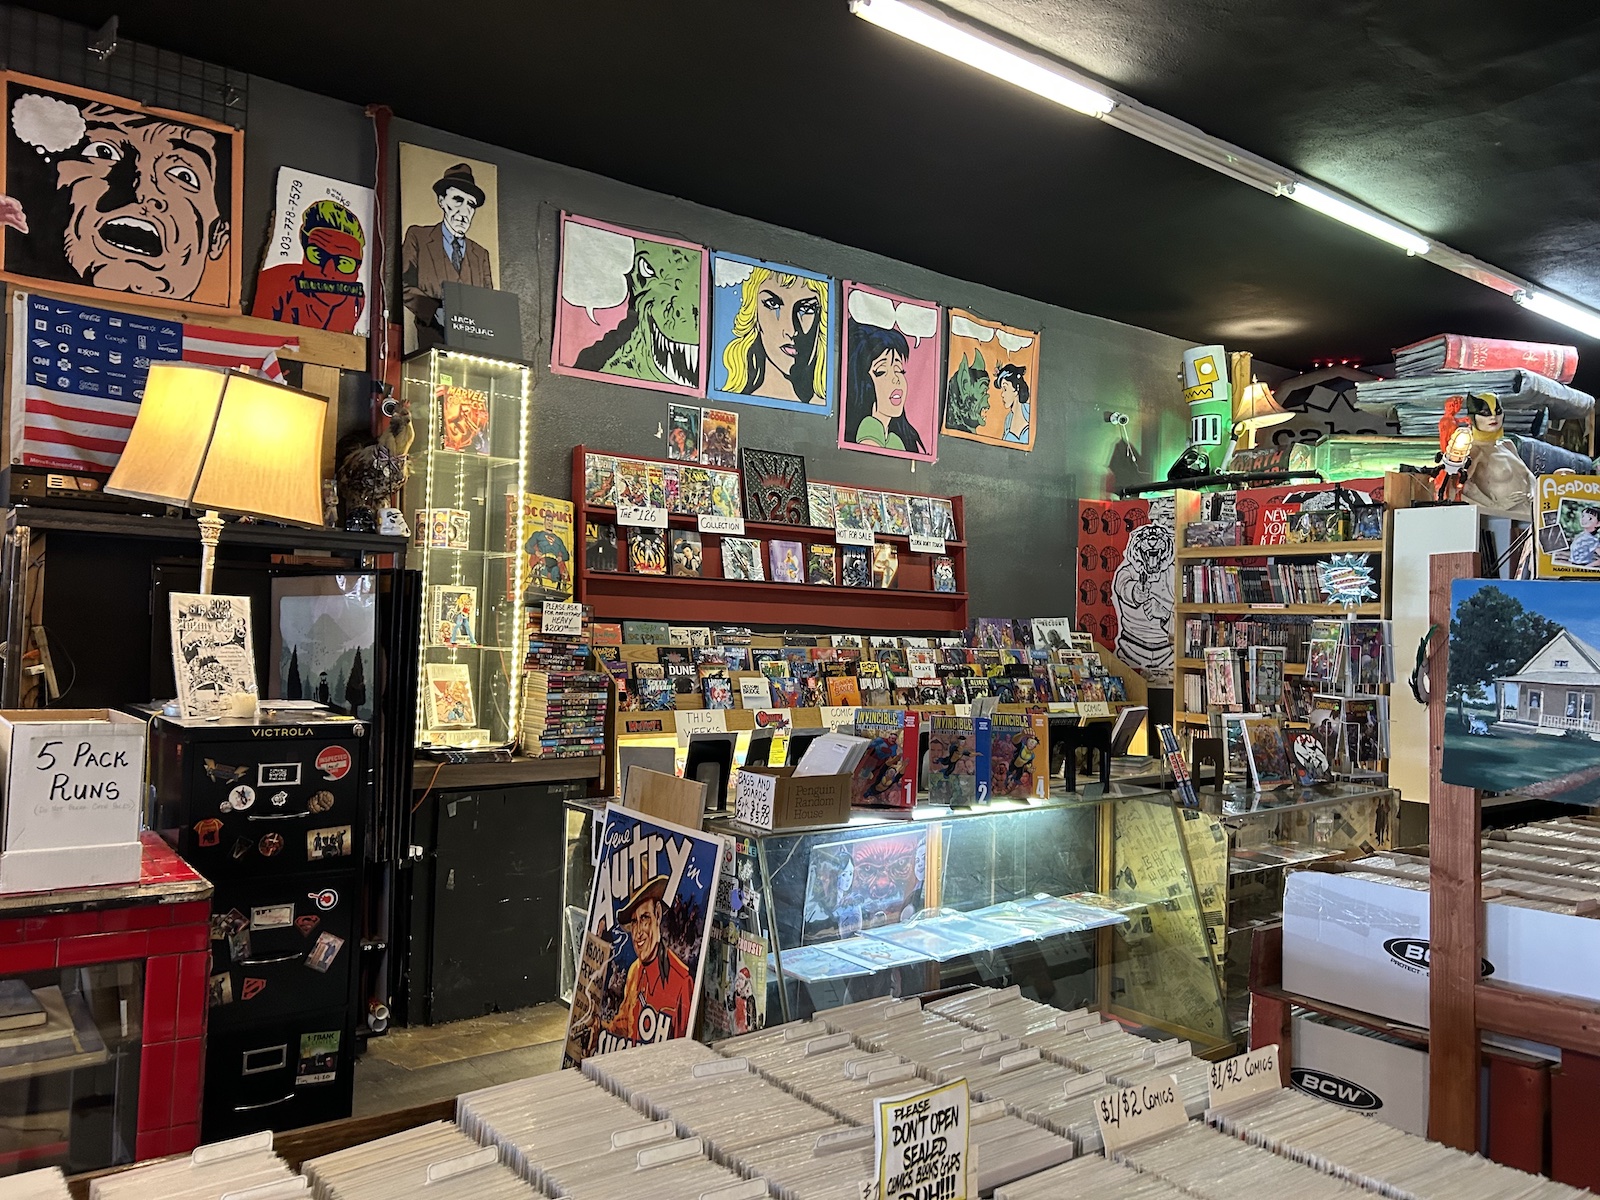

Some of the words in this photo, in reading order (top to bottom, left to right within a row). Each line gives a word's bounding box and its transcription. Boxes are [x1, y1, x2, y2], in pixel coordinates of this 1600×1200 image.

[280, 180, 303, 257] 303-778-7579
[34, 303, 49, 312] VISA
[451, 315, 476, 325] JACK
[105, 334, 128, 345] Google
[77, 348, 100, 357] EXXON
[32, 356, 50, 367] CNN
[447, 386, 486, 402] MARVEL
[447, 396, 484, 411] COMICS
[685, 471, 710, 482] X-MEN
[836, 491, 858, 504] HULK
[620, 508, 632, 518] THE
[752, 490, 802, 524] 126
[1543, 502, 1551, 510] 3
[700, 517, 740, 531] COLLECTION
[836, 530, 846, 539] NOT
[848, 531, 857, 540] FOR
[858, 531, 872, 541] SALE
[552, 616, 573, 625] HEAVY
[669, 665, 697, 676] DUNE
[686, 711, 713, 724] THIS
[830, 708, 853, 718] COMIC
[857, 711, 899, 726] INVINCIBLE
[933, 717, 973, 731] INVINCIBLE
[991, 714, 1029, 728] INVINCIBLE
[251, 728, 314, 737] VICTROLA
[36, 741, 63, 771] 5
[73, 742, 129, 768] PACK
[1170, 755, 1181, 780] MONICA
[1177, 753, 1188, 779] MONICA
[49, 773, 120, 801] RUNS
[738, 772, 754, 787] BAGS
[757, 779, 770, 791] AND
[1036, 779, 1045, 798] 4
[743, 785, 767, 802] BOARDS
[796, 786, 836, 796] Penguin
[904, 783, 912, 804] 1
[978, 785, 987, 804] 2
[795, 797, 835, 808] Random
[794, 809, 825, 820] House
[604, 822, 631, 855] Gene
[1390, 957, 1421, 975] PROTECT
[638, 1004, 672, 1042] OH
[1301, 1074, 1361, 1102] BCW
[894, 1098, 931, 1120] PLEASE
[892, 1114, 929, 1147] DON'T
[930, 1105, 959, 1135] OPEN
[903, 1136, 948, 1171] SEALED
[887, 1168, 914, 1196] COMICS
[915, 1158, 939, 1184] BOOKS
